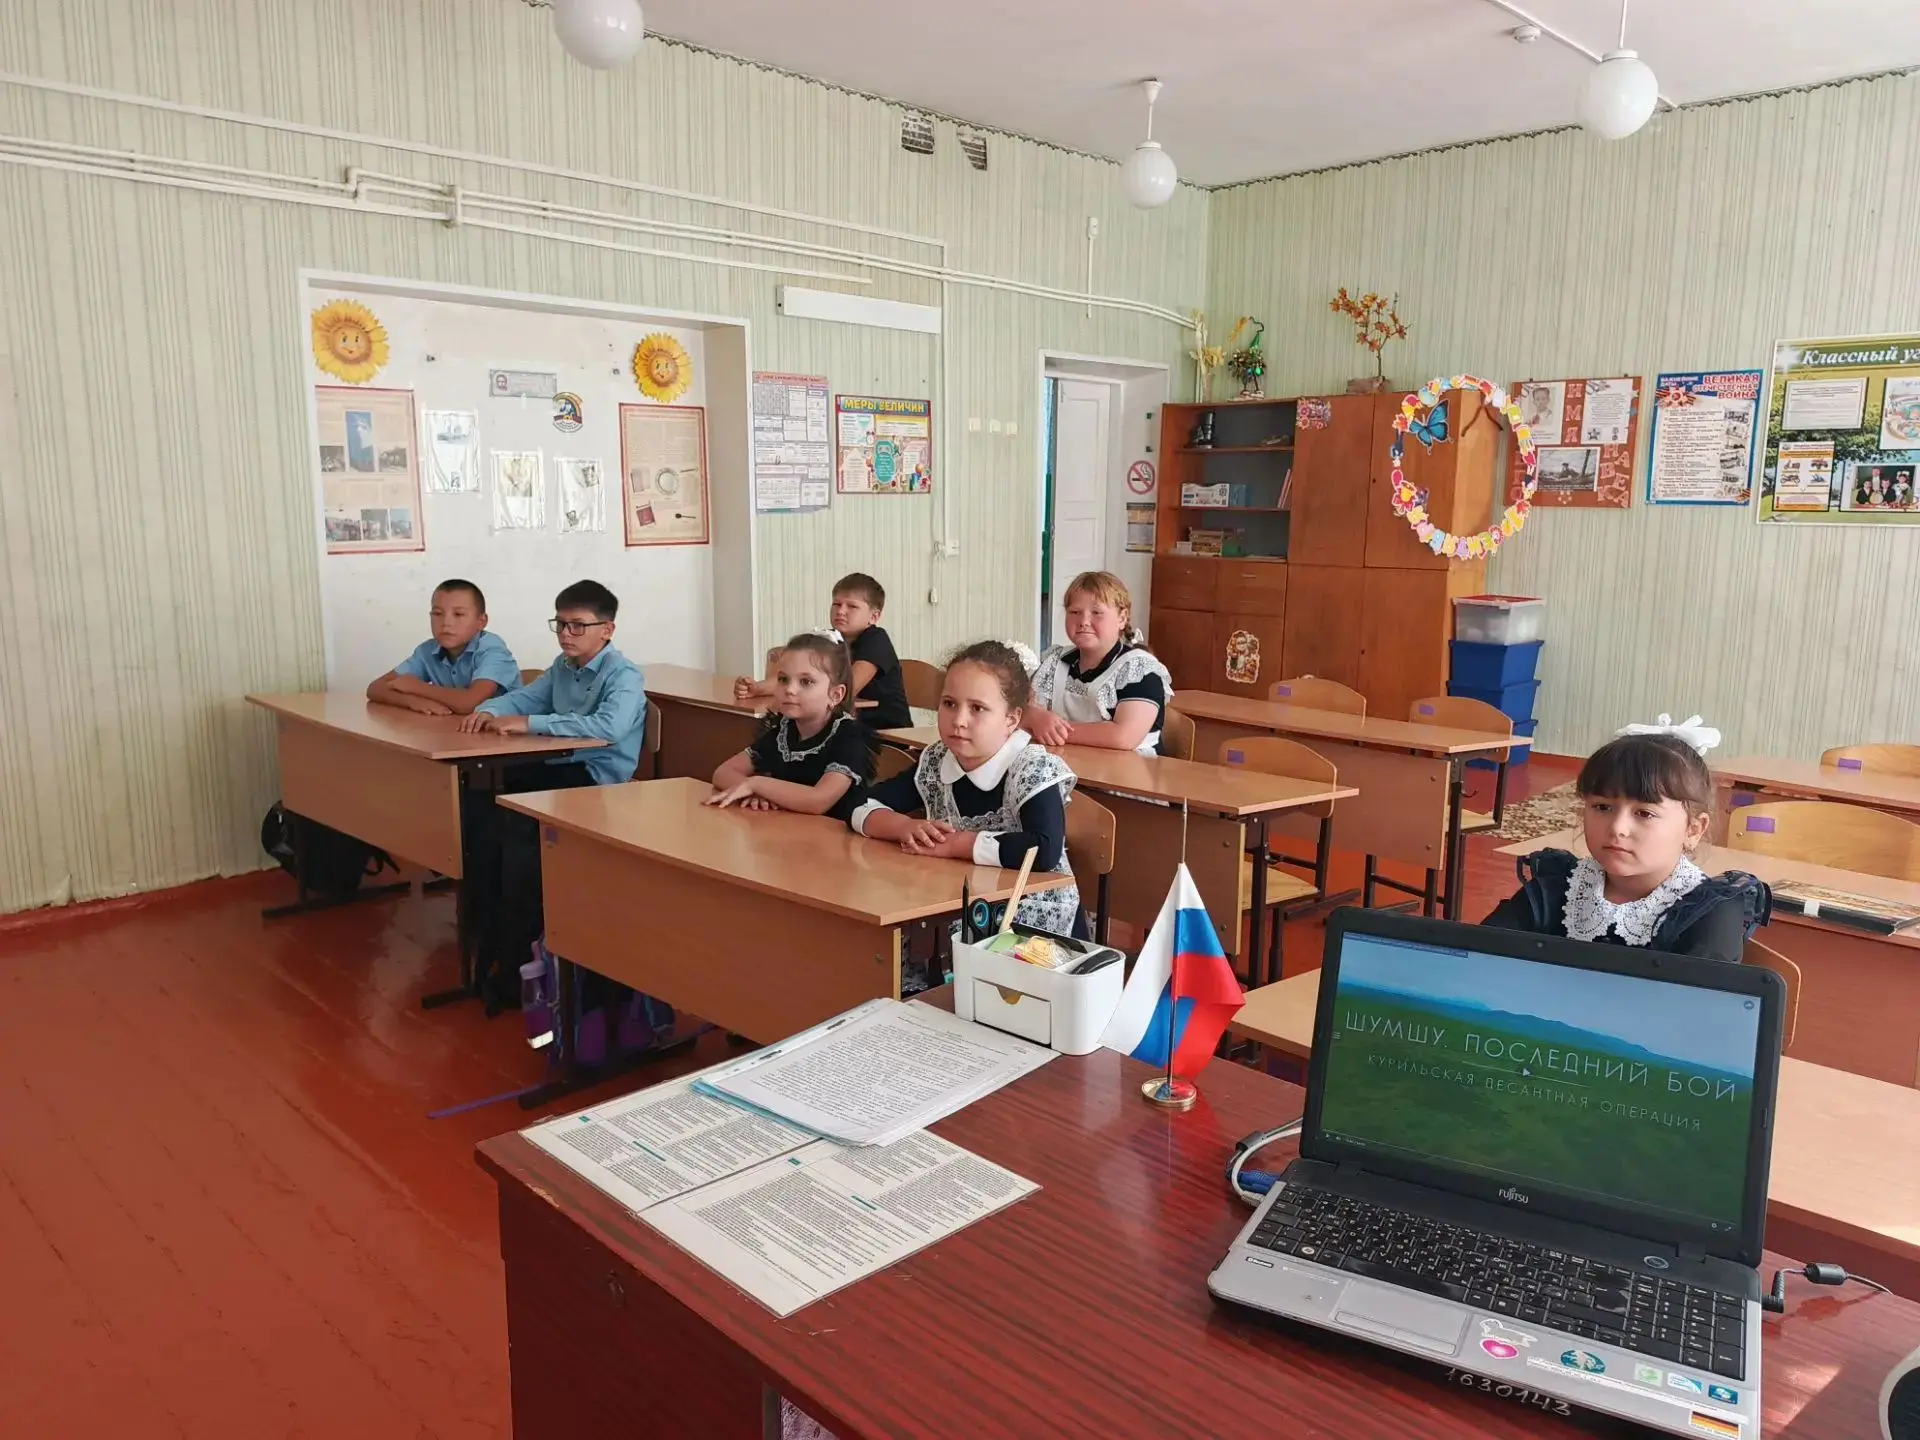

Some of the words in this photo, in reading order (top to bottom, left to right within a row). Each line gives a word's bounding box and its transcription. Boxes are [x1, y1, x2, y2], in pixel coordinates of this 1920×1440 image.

[1802, 346, 1897, 366] Классный
[1692, 383, 1758, 393] ОТЕЧЕСТВЕННАЯ
[1703, 374, 1759, 385] ВЕЛИКАЯ
[845, 399, 876, 410] МЕРЫ
[880, 401, 924, 413] ВЕЛИЧИН
[1346, 1011, 1448, 1048] ШУМШУ.
[1465, 1033, 1648, 1087] ПОСЛЕДНИЙ
[1667, 1070, 1736, 1103] БОЙ
[1368, 1055, 1475, 1086] КУРИЛЬСКАЯ
[1485, 1077, 1589, 1110] ДЕСАНТНАЯ
[1600, 1100, 1702, 1131] ОПЕРАЦИЯ
[1498, 1187, 1529, 1204] FUJITSU
